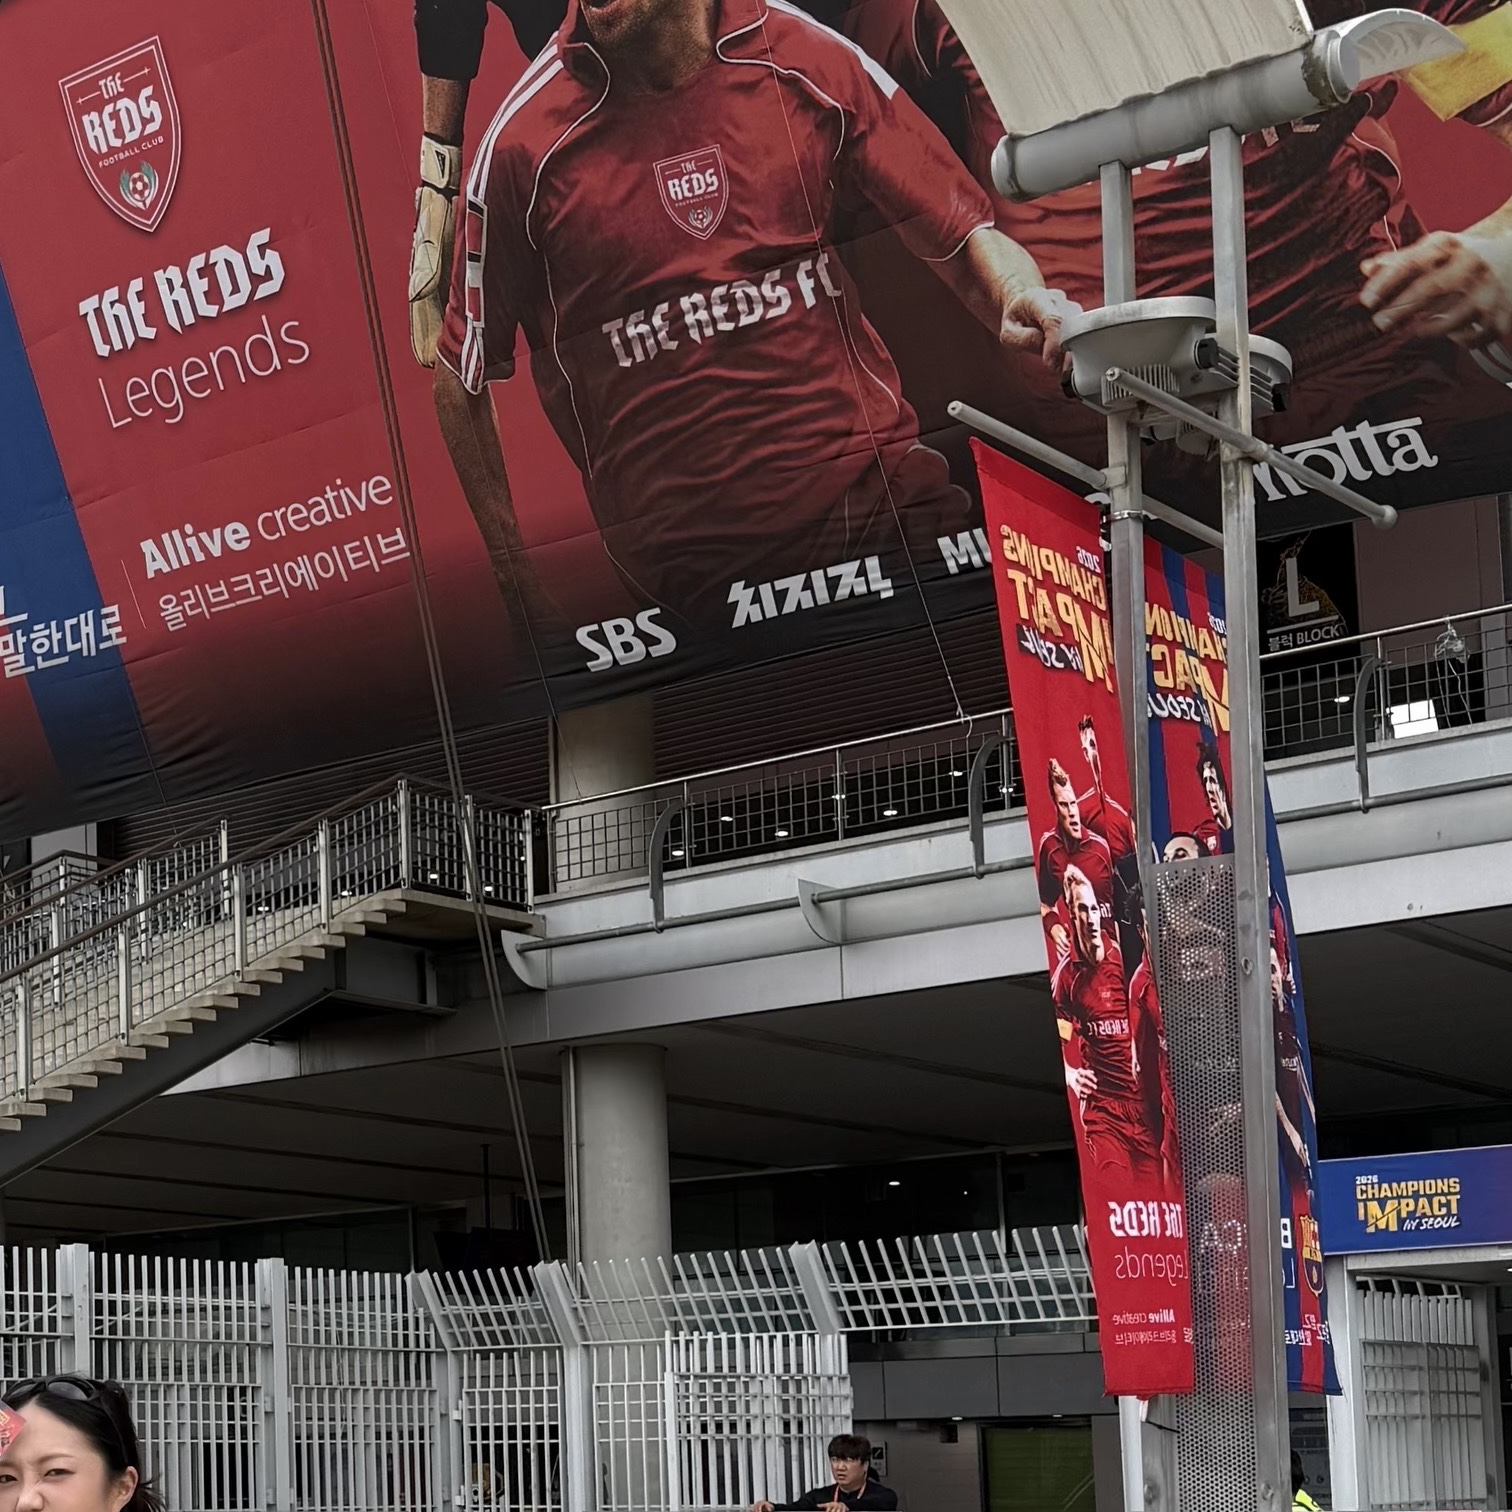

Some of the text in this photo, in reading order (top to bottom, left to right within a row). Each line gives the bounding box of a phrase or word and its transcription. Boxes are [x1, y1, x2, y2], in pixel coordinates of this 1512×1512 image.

[81, 85, 162, 155] REDS
[98, 136, 164, 168] FOOTBALL CLUB
[667, 168, 719, 200] REDS
[79, 227, 285, 357] THE REDS
[601, 252, 842, 368] THE REDS FC
[97, 315, 310, 428] Legends
[140, 475, 393, 579] Allive creative
[159, 527, 411, 632] 올리브크리에이티브
[1286, 556, 1320, 617] L
[575, 607, 677, 672] SBS
[1296, 624, 1340, 645] BLOCK
[1355, 1175, 1379, 1184] 2026
[1356, 1177, 1460, 1200] CHAMPIONS
[1357, 1194, 1460, 1233] IMPACT
[1420, 1216, 1461, 1230] SEOUL
